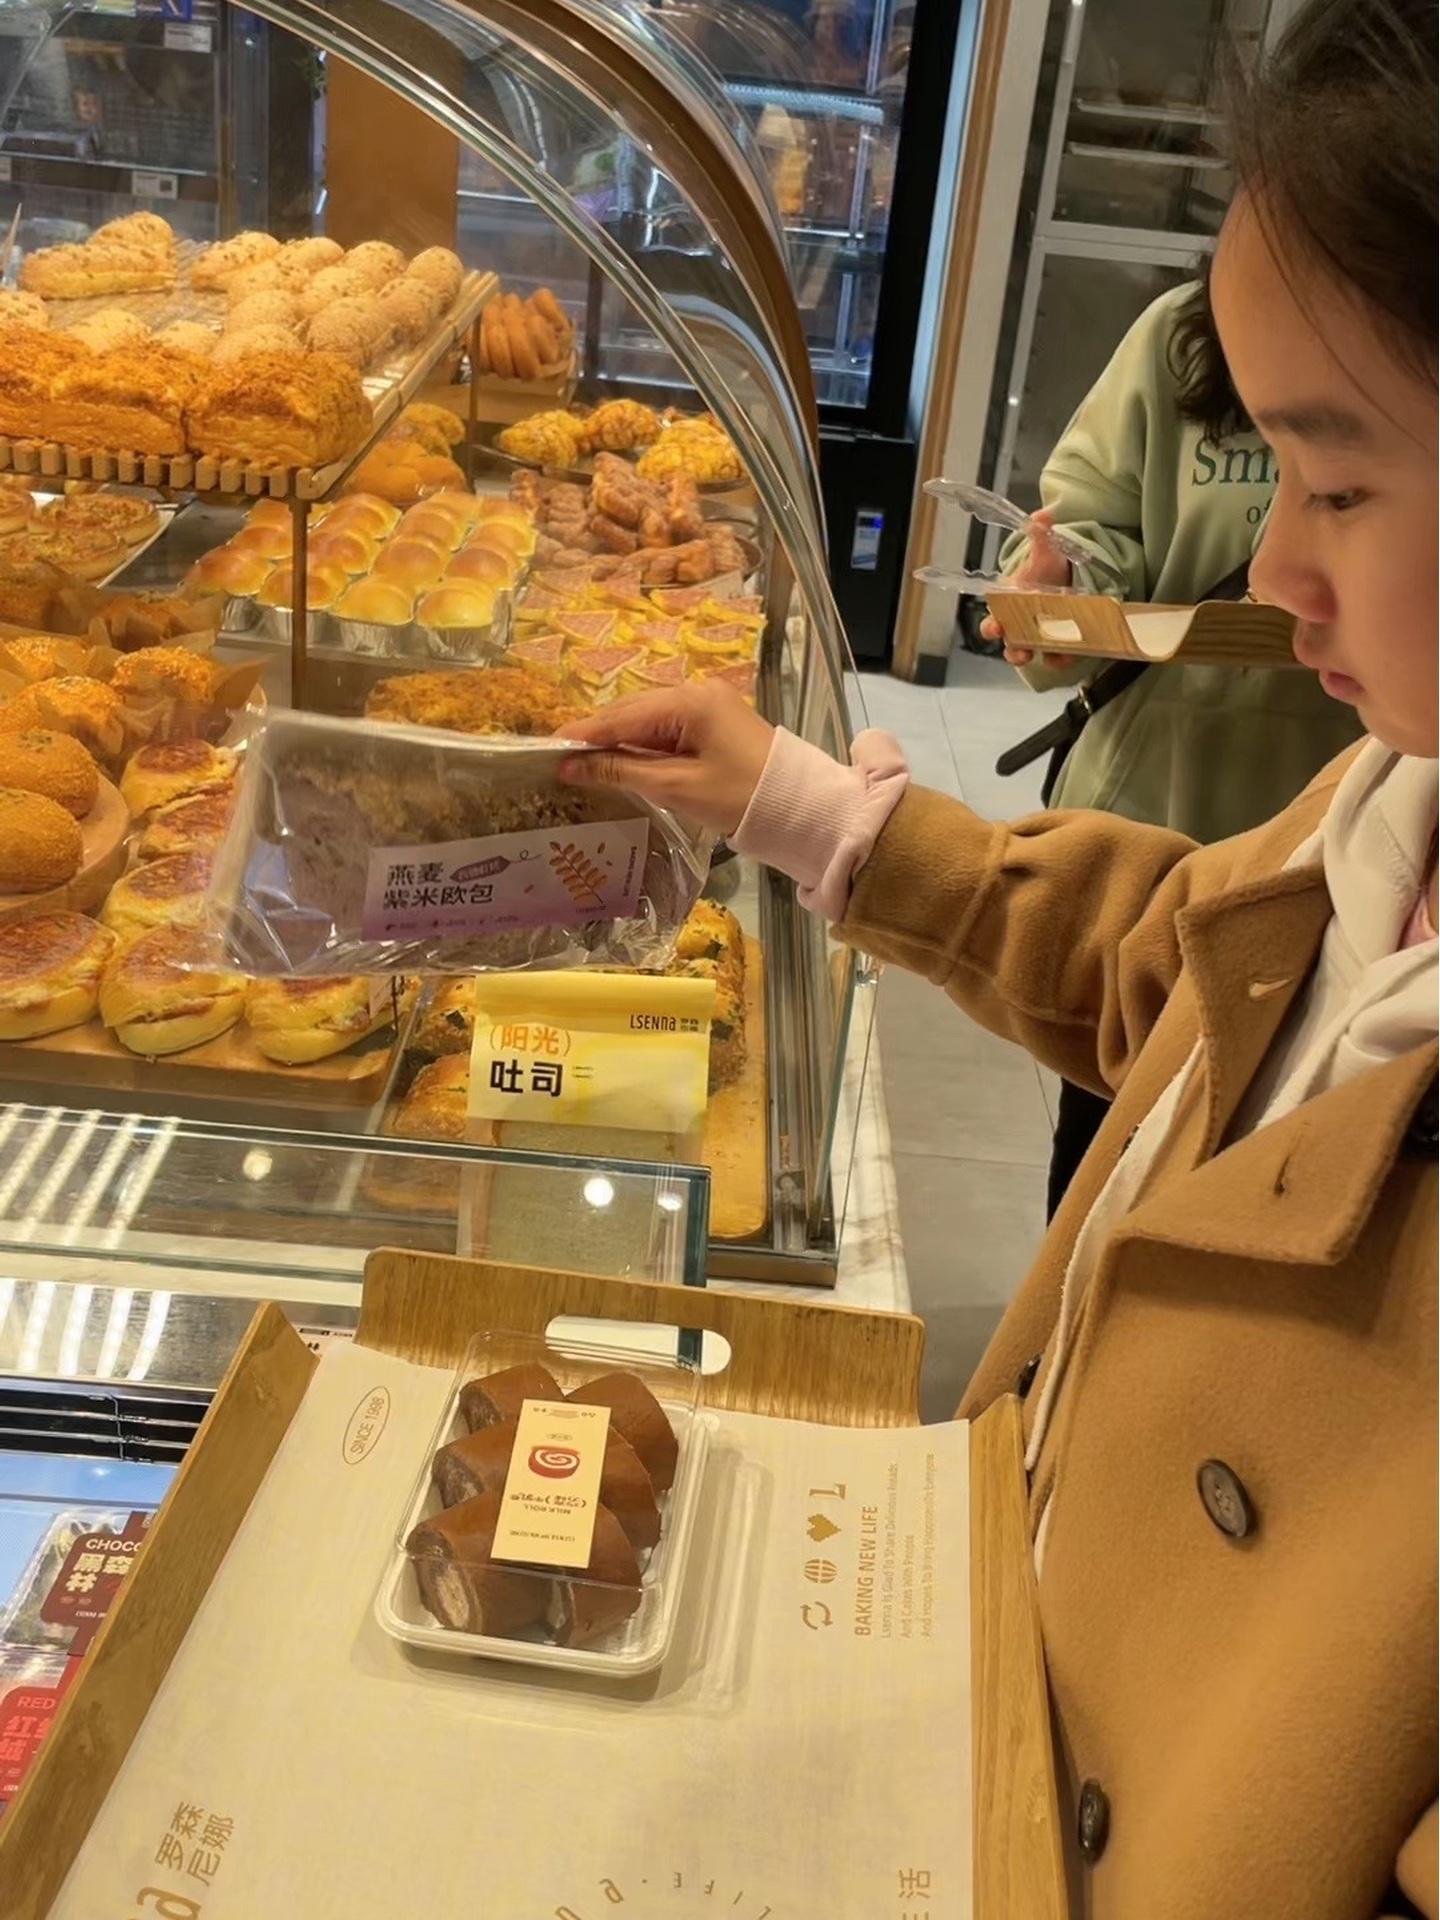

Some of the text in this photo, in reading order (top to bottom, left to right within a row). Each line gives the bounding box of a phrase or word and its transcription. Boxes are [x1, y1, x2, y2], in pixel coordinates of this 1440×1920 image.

[1192, 439, 1280, 486] Sm
[386, 862, 443, 887] 燕麦
[383, 884, 493, 909] 紫米欧包
[490, 1059, 563, 1097] 吐司
[350, 1422, 375, 1455] SINCE
[854, 1506, 879, 1636] BAKING NEW LIFE
[17, 1696, 56, 1709] RED
[154, 1801, 204, 1871] 罗森
[187, 1814, 235, 1887] 尼娜
[898, 1867, 931, 1920] 活
